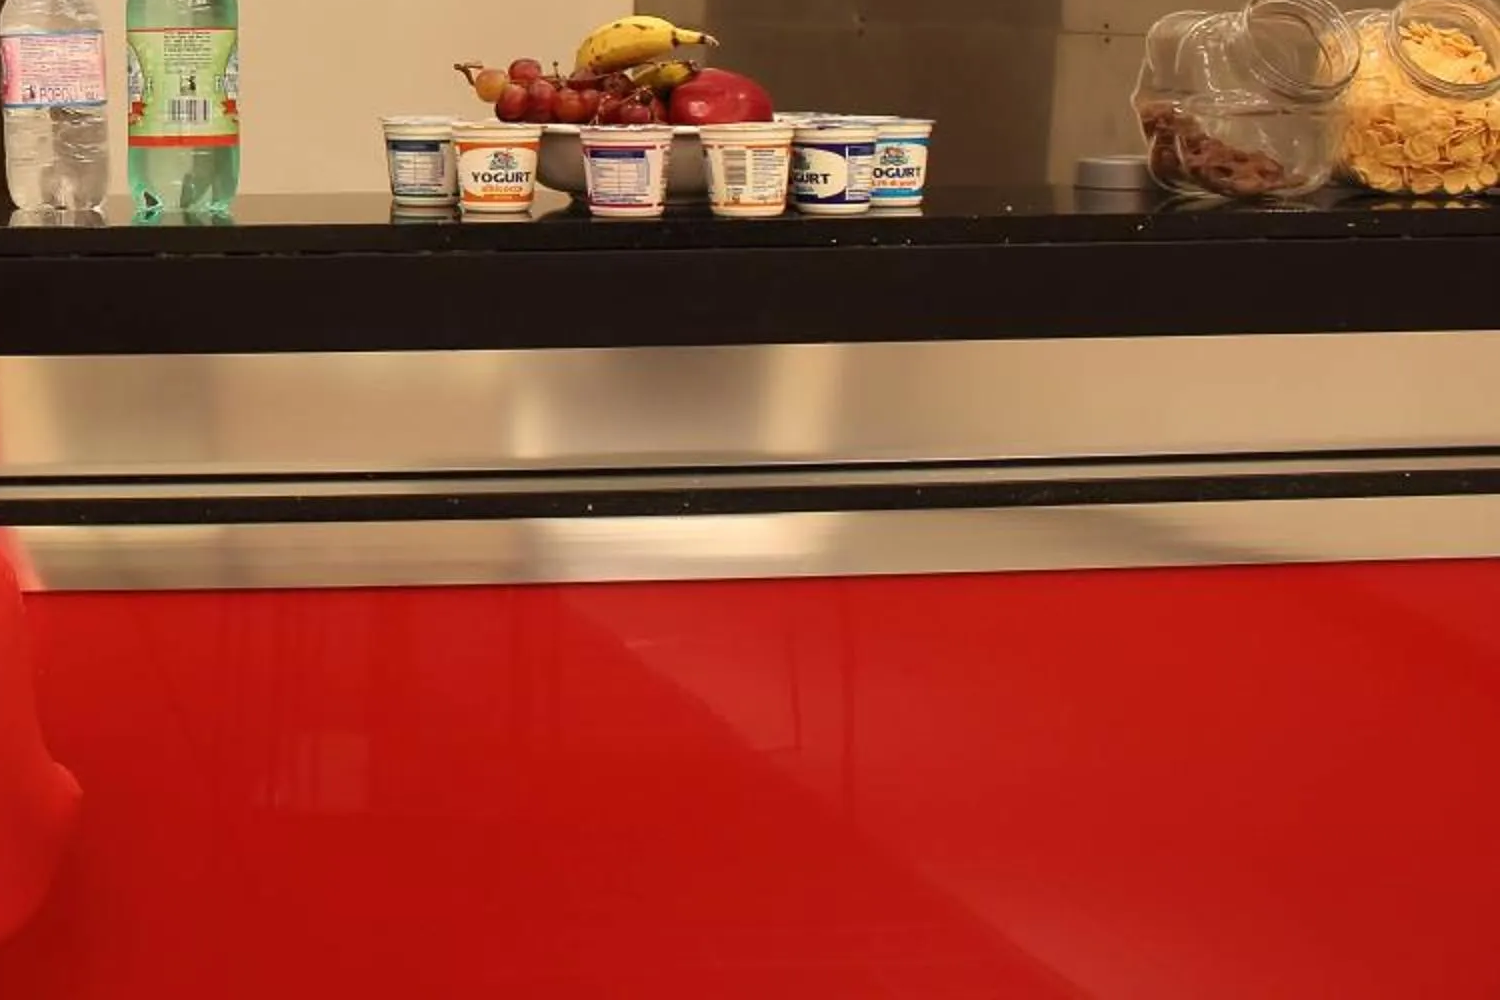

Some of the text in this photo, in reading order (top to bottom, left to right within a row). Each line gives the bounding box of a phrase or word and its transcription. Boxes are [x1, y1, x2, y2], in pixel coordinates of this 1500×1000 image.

[471, 171, 531, 183] YOGURT
[794, 172, 831, 184] GURT
[873, 167, 921, 178] OGURT
